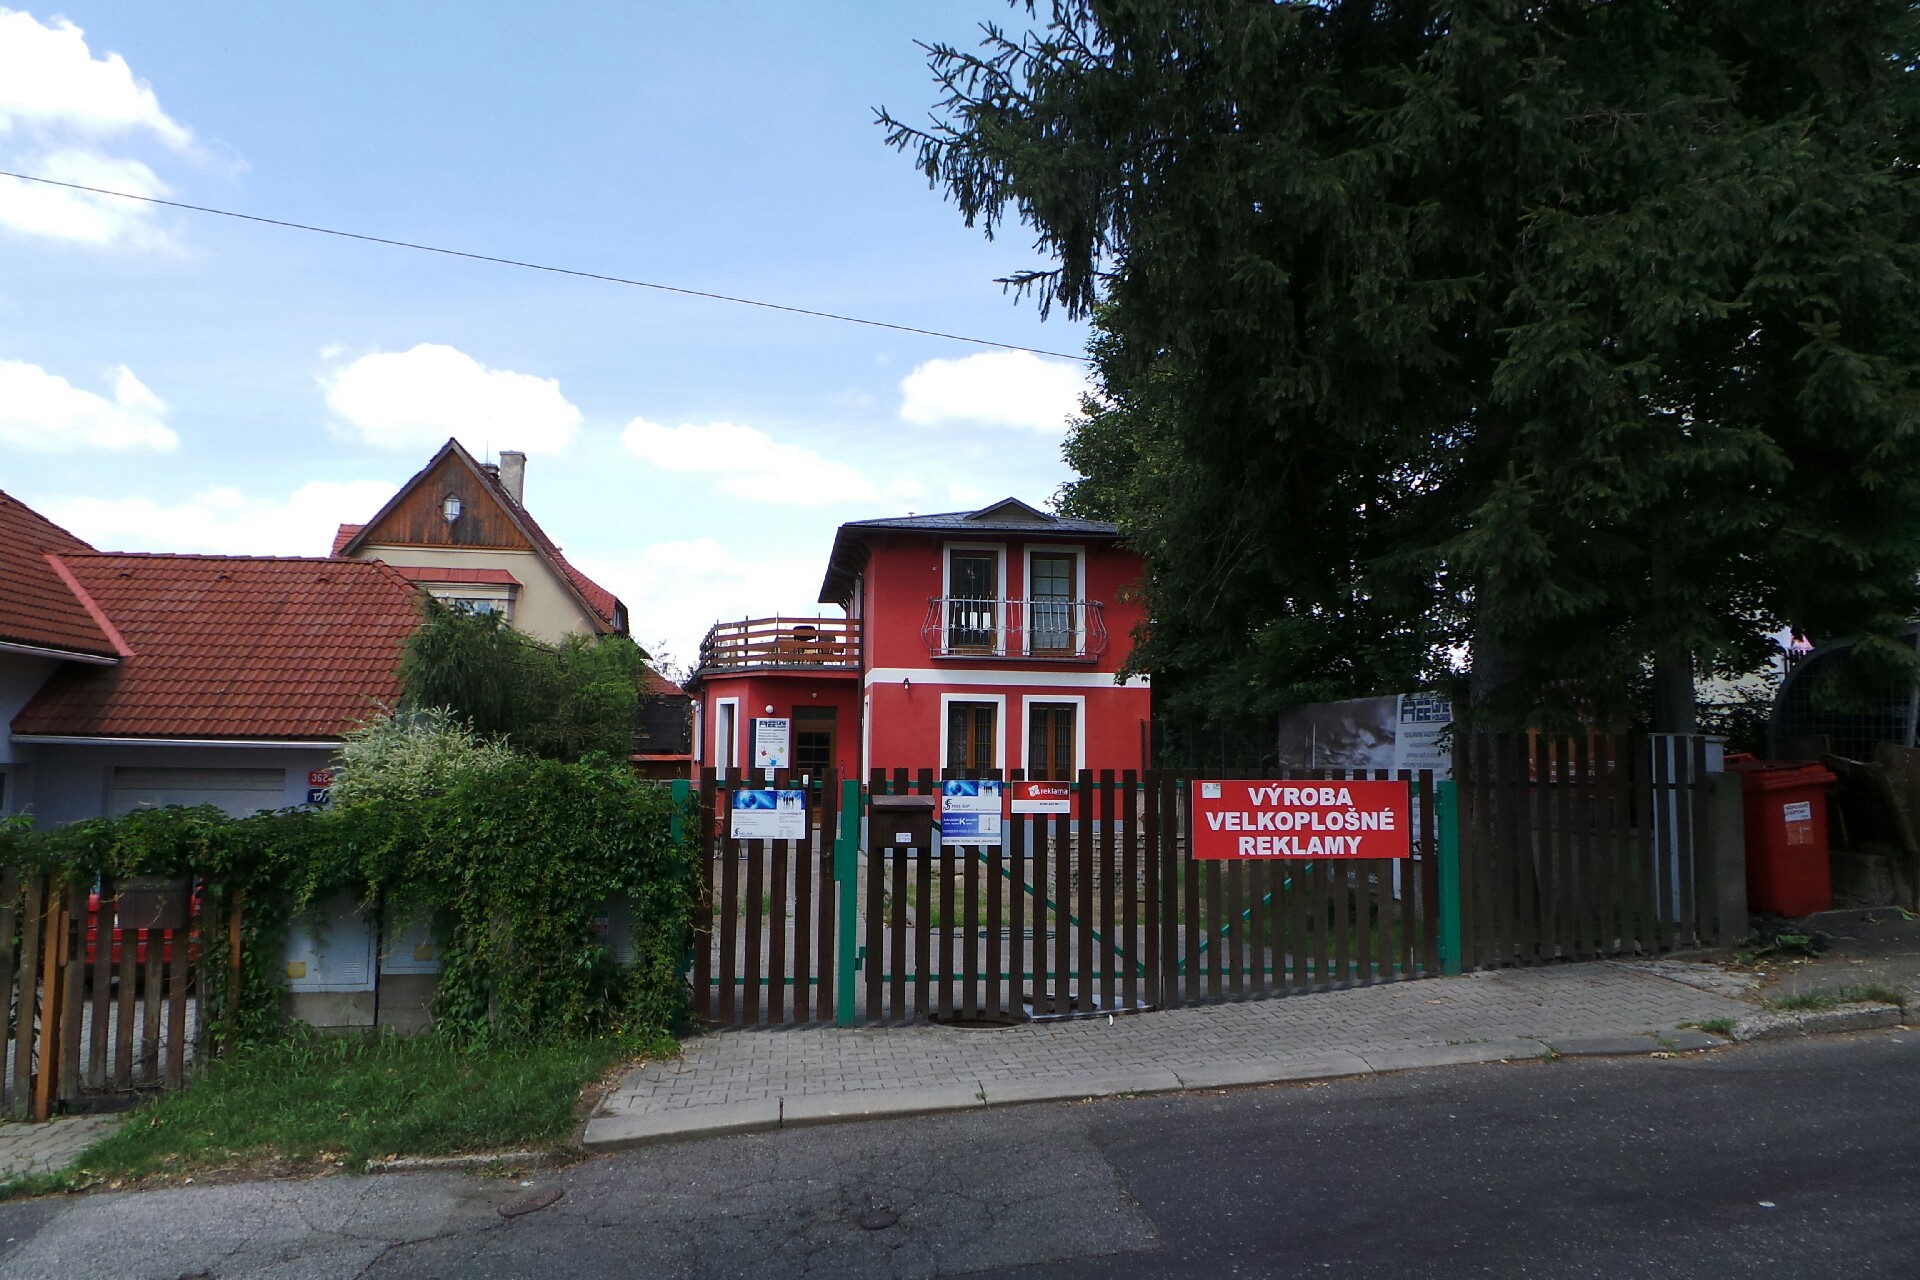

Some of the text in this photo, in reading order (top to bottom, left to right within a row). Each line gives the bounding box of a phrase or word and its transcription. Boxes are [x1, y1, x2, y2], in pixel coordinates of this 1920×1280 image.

[311, 773, 327, 782] 362
[1040, 787, 1068, 795] reklama
[1248, 783, 1353, 806] VÝROBA
[1205, 807, 1395, 831] VELKOPLOŠNÉ
[1238, 836, 1362, 855] REKLAMY
